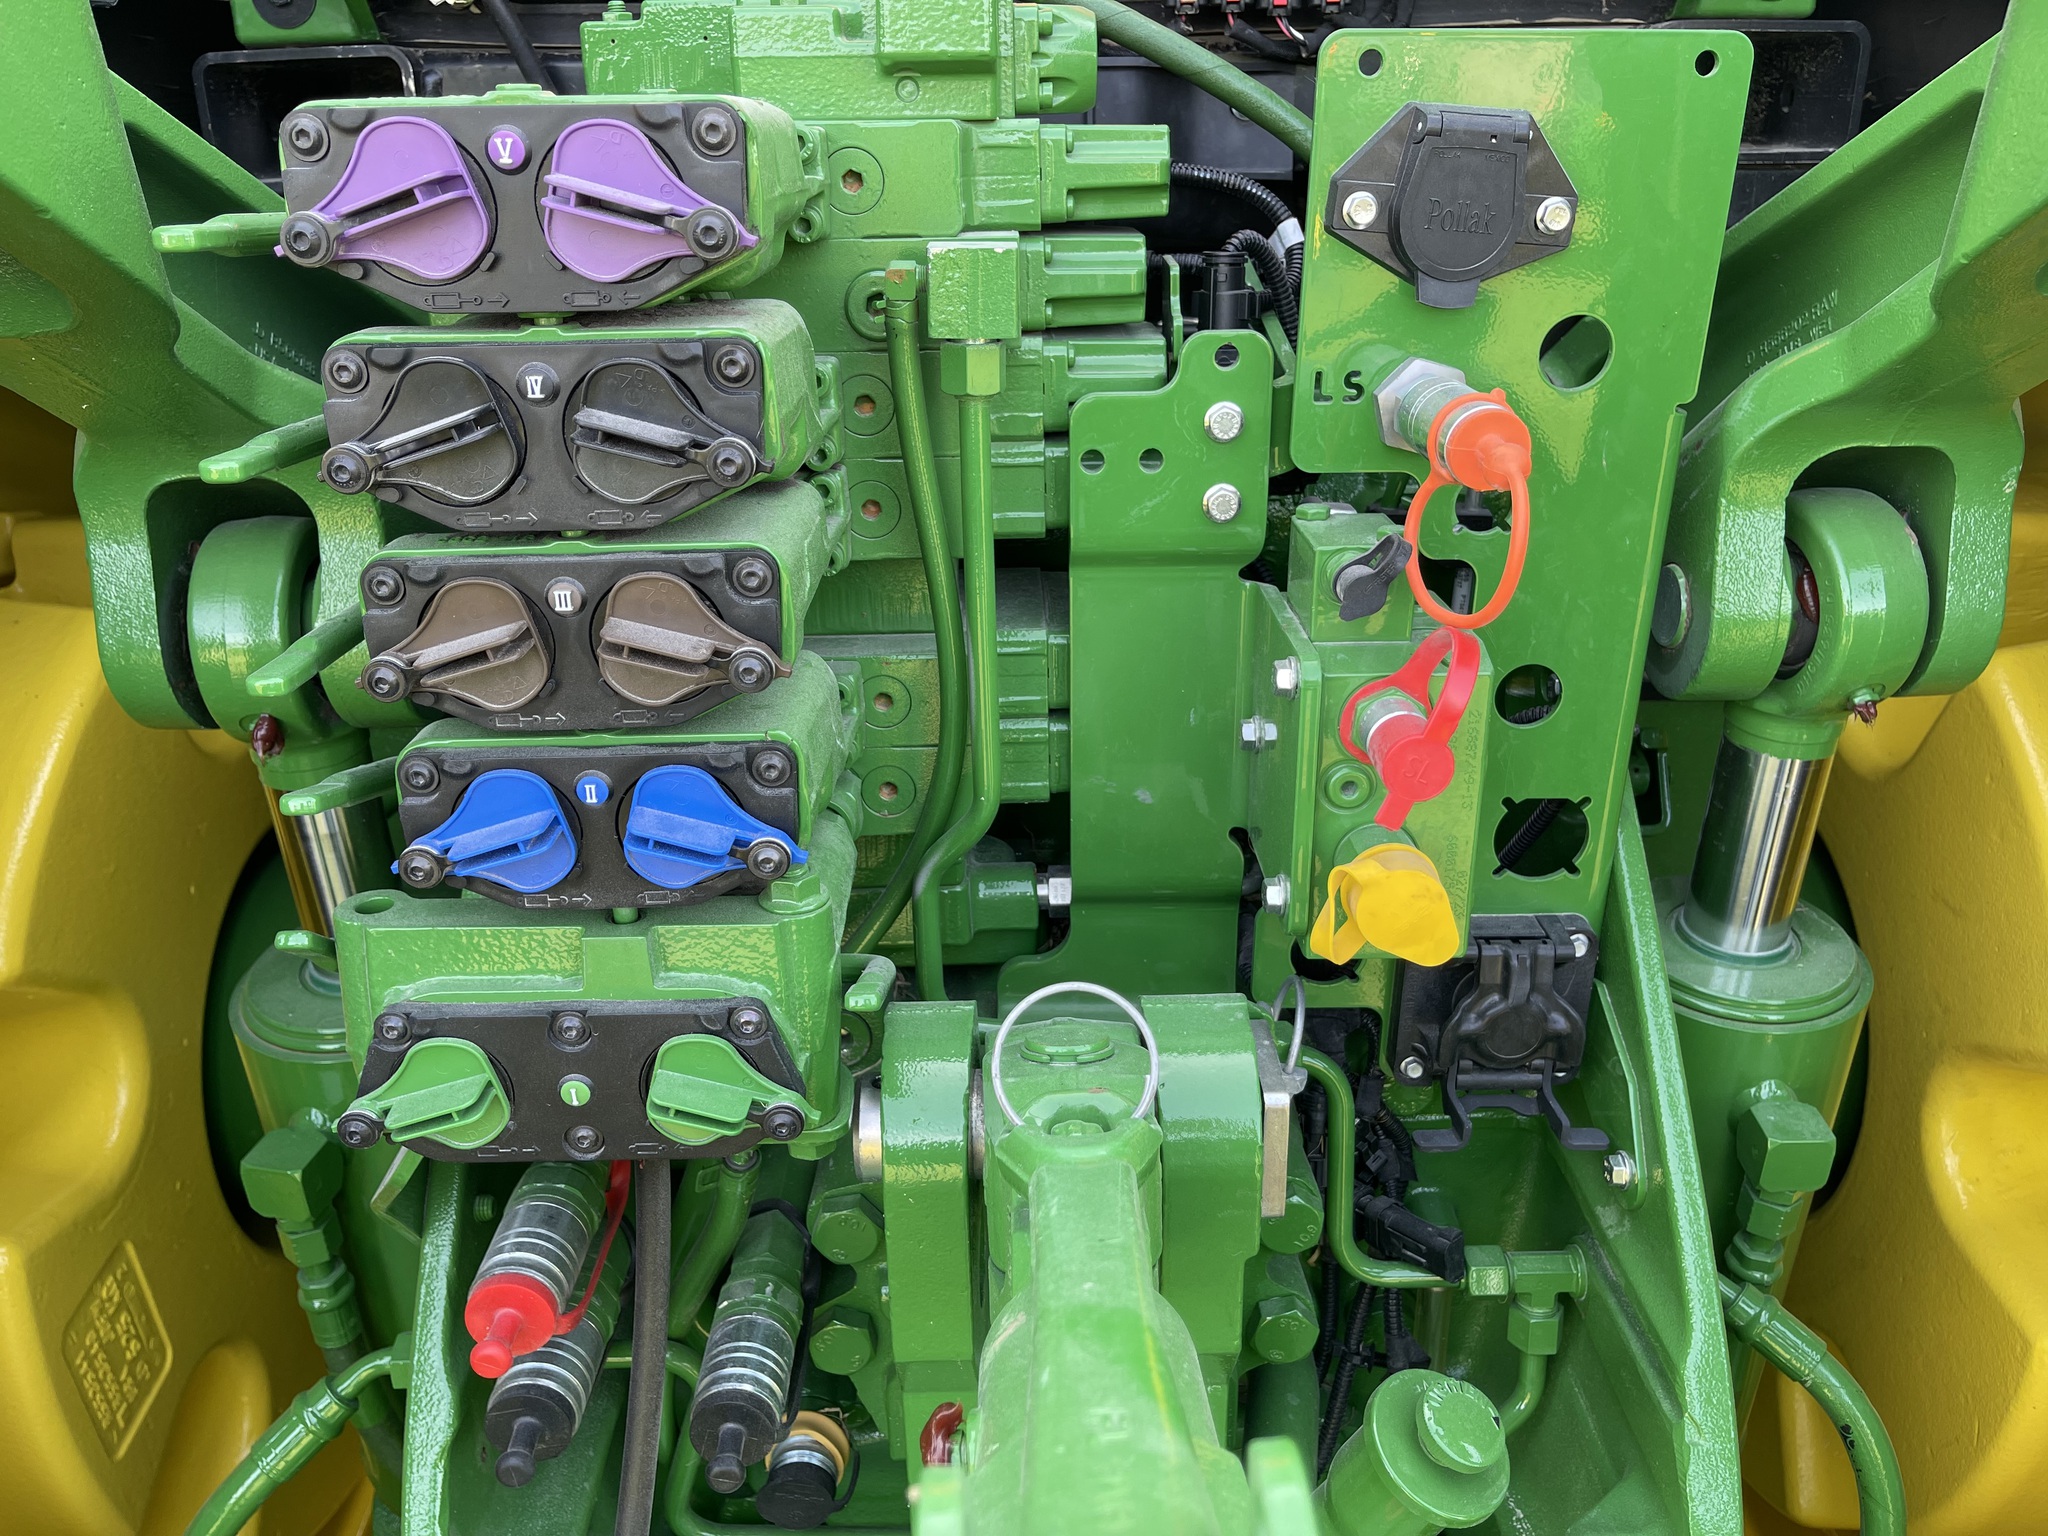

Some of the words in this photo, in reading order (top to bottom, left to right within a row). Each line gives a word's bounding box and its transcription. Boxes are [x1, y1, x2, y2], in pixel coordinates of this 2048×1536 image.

[493, 137, 514, 164] V
[1423, 197, 1496, 236] Pollak
[525, 375, 546, 400] IV
[1313, 370, 1366, 406] LS
[554, 589, 573, 611] III
[584, 785, 598, 803] II
[570, 1088, 580, 1106] I
